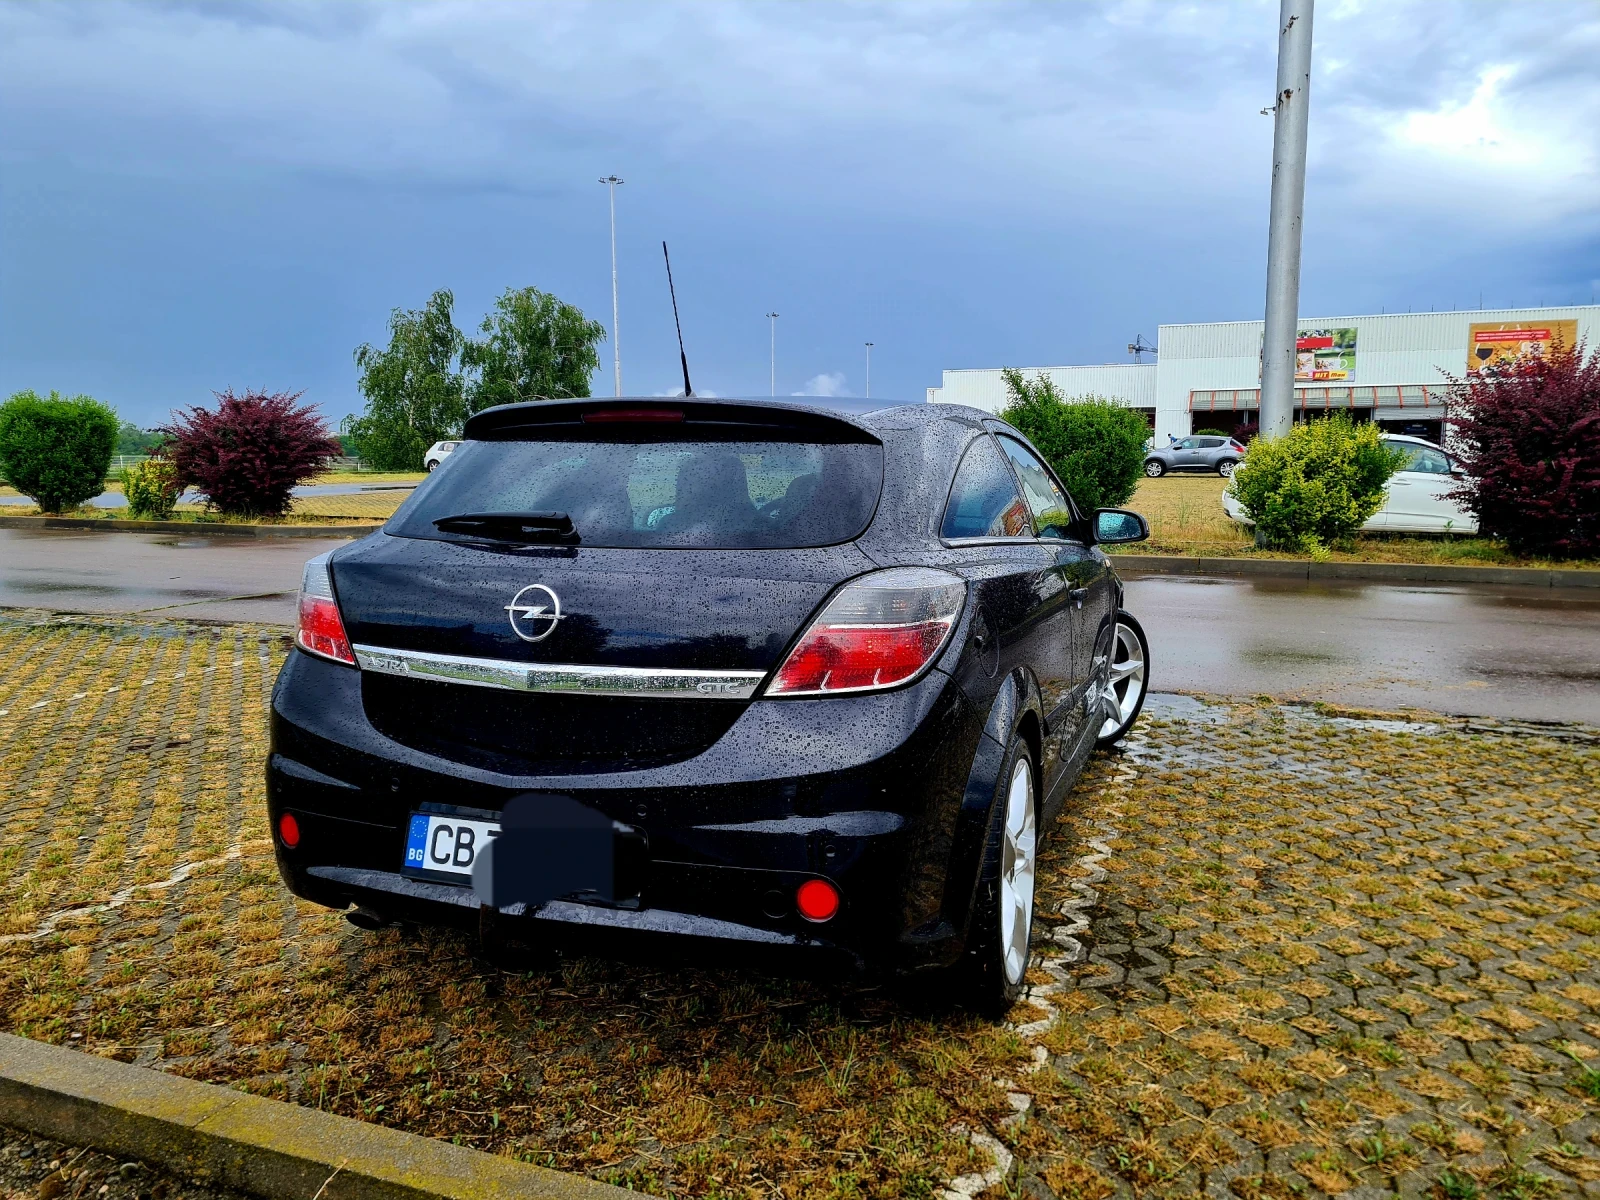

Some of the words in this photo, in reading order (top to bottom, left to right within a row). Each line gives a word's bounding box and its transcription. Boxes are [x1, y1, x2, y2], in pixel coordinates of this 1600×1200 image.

[368, 656, 409, 673] ASTRA
[696, 682, 740, 694] GTC
[408, 847, 424, 861] BG
